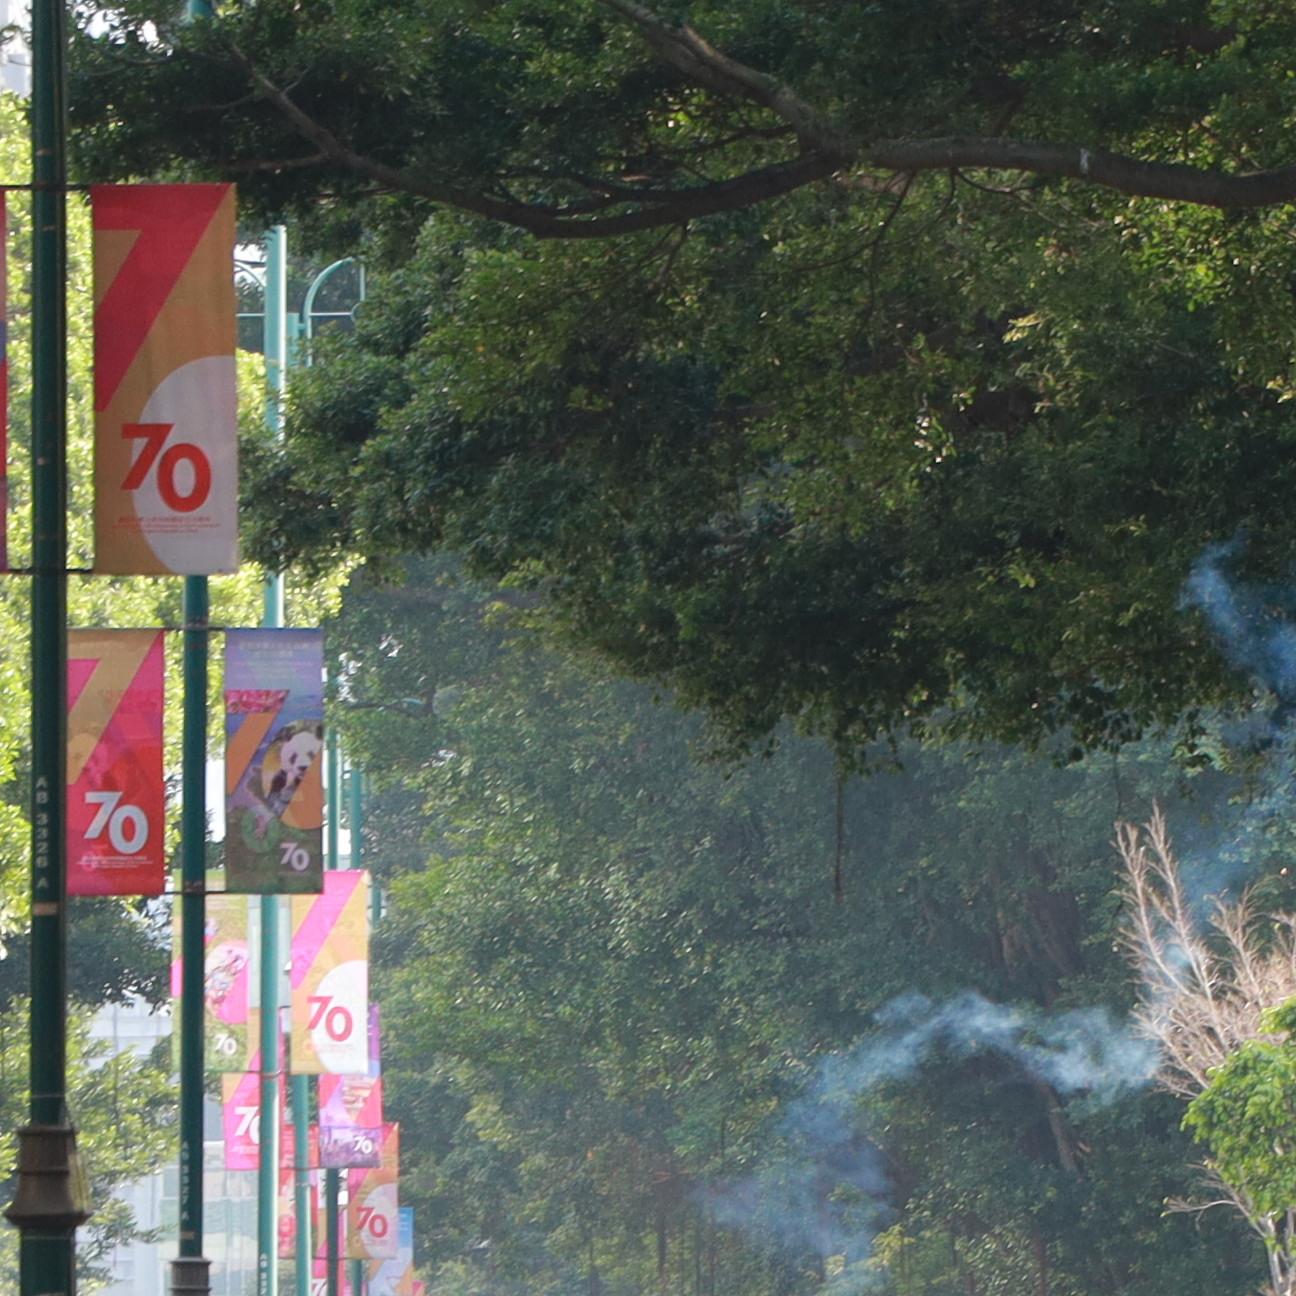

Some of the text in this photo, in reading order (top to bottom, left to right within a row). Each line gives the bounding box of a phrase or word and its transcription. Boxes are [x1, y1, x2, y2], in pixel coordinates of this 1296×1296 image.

[120, 423, 211, 512] 70
[84, 791, 149, 854] 70
[280, 843, 310, 872] 70
[306, 996, 353, 1042] 70
[214, 1033, 237, 1056] 70
[353, 1135, 373, 1154] 70
[356, 1206, 388, 1238] 70
